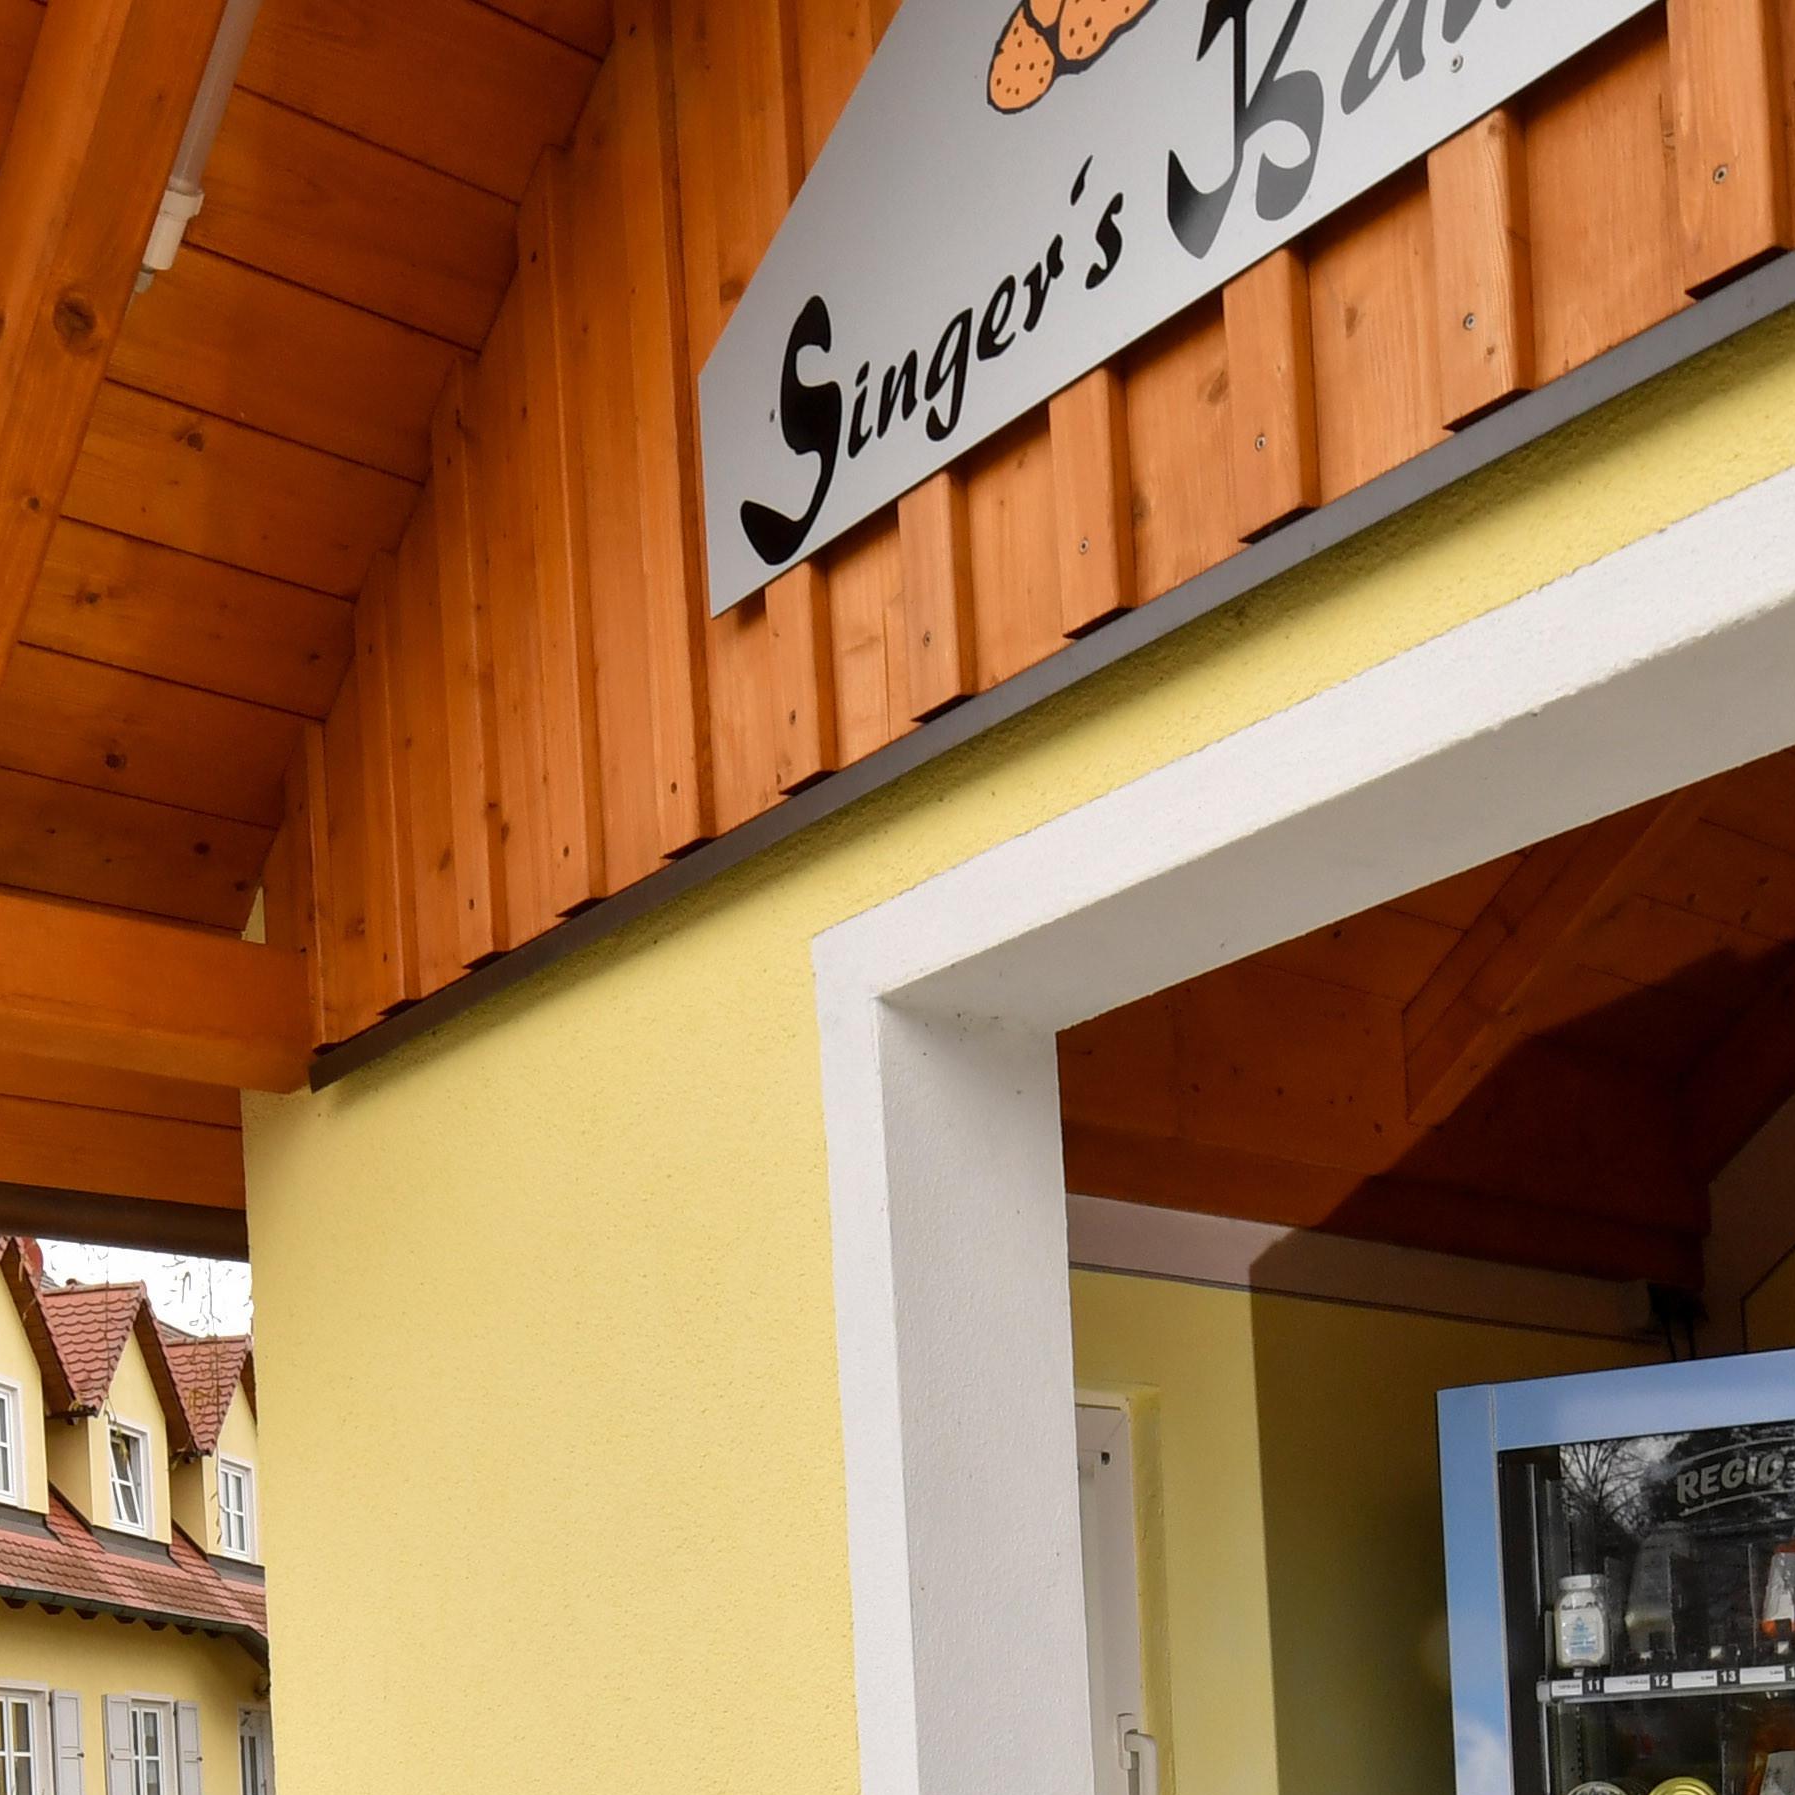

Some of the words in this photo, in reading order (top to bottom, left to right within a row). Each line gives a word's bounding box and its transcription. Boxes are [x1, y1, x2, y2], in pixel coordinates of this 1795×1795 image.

[1168, 0, 1507, 259] Ba
[1587, 1680, 1601, 1691] 11
[1654, 1675, 1669, 1686] 12
[1720, 1670, 1737, 1682] 13
